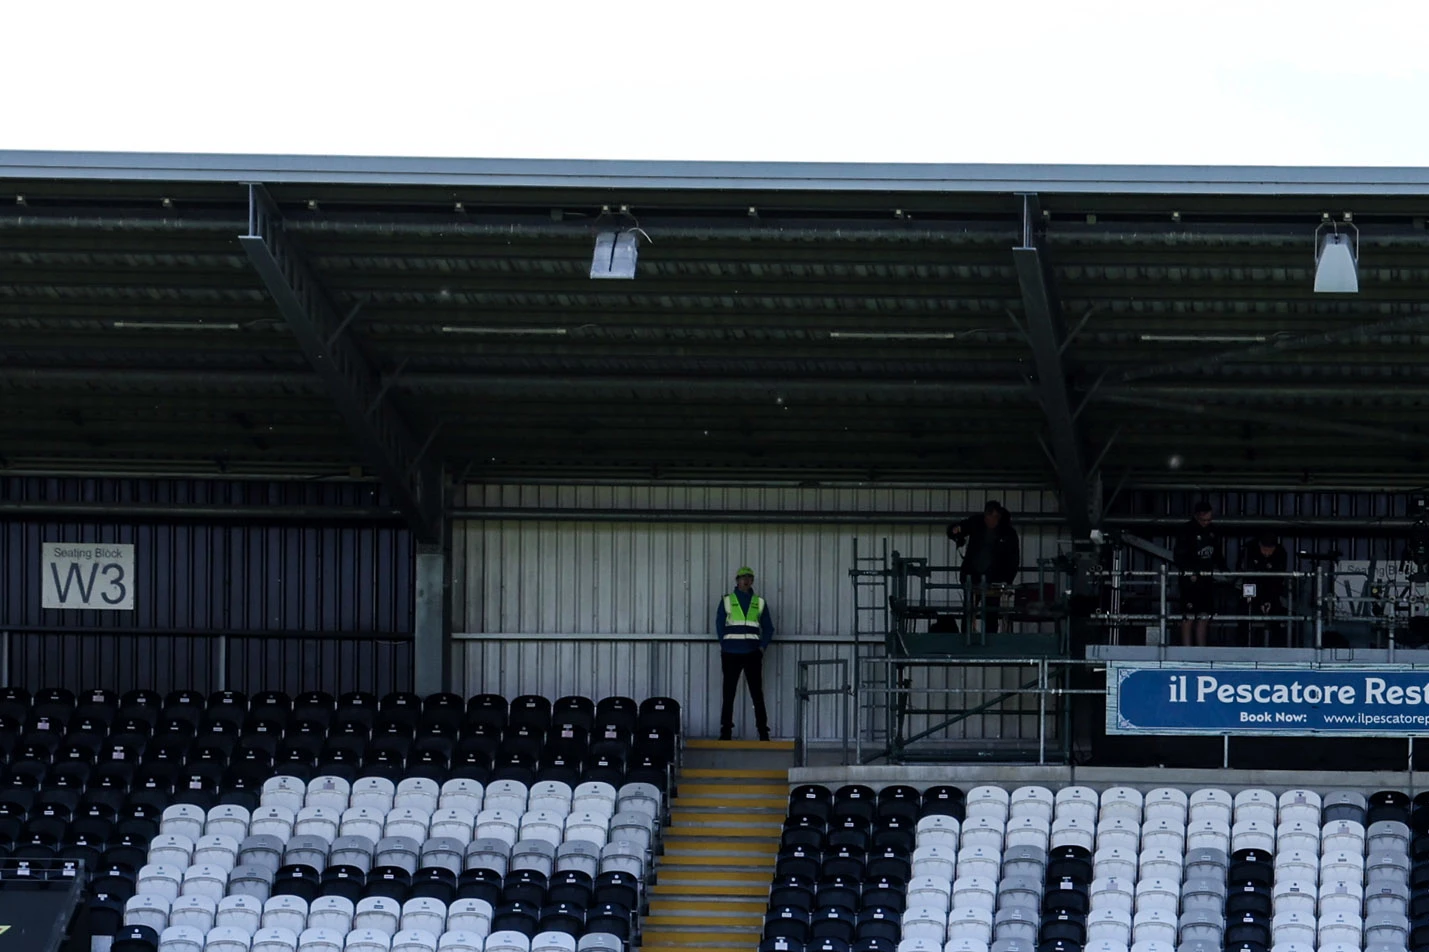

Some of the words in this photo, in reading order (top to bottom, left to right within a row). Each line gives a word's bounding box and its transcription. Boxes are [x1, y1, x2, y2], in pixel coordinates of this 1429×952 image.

[54, 548, 92, 559] Seating
[95, 548, 123, 558] Block
[1348, 564, 1384, 577] Seang
[50, 562, 126, 604] W3
[1168, 675, 1187, 702] il
[1197, 676, 1356, 704] Pescatore
[1240, 712, 1273, 723] Book
[1276, 713, 1307, 723] Now:
